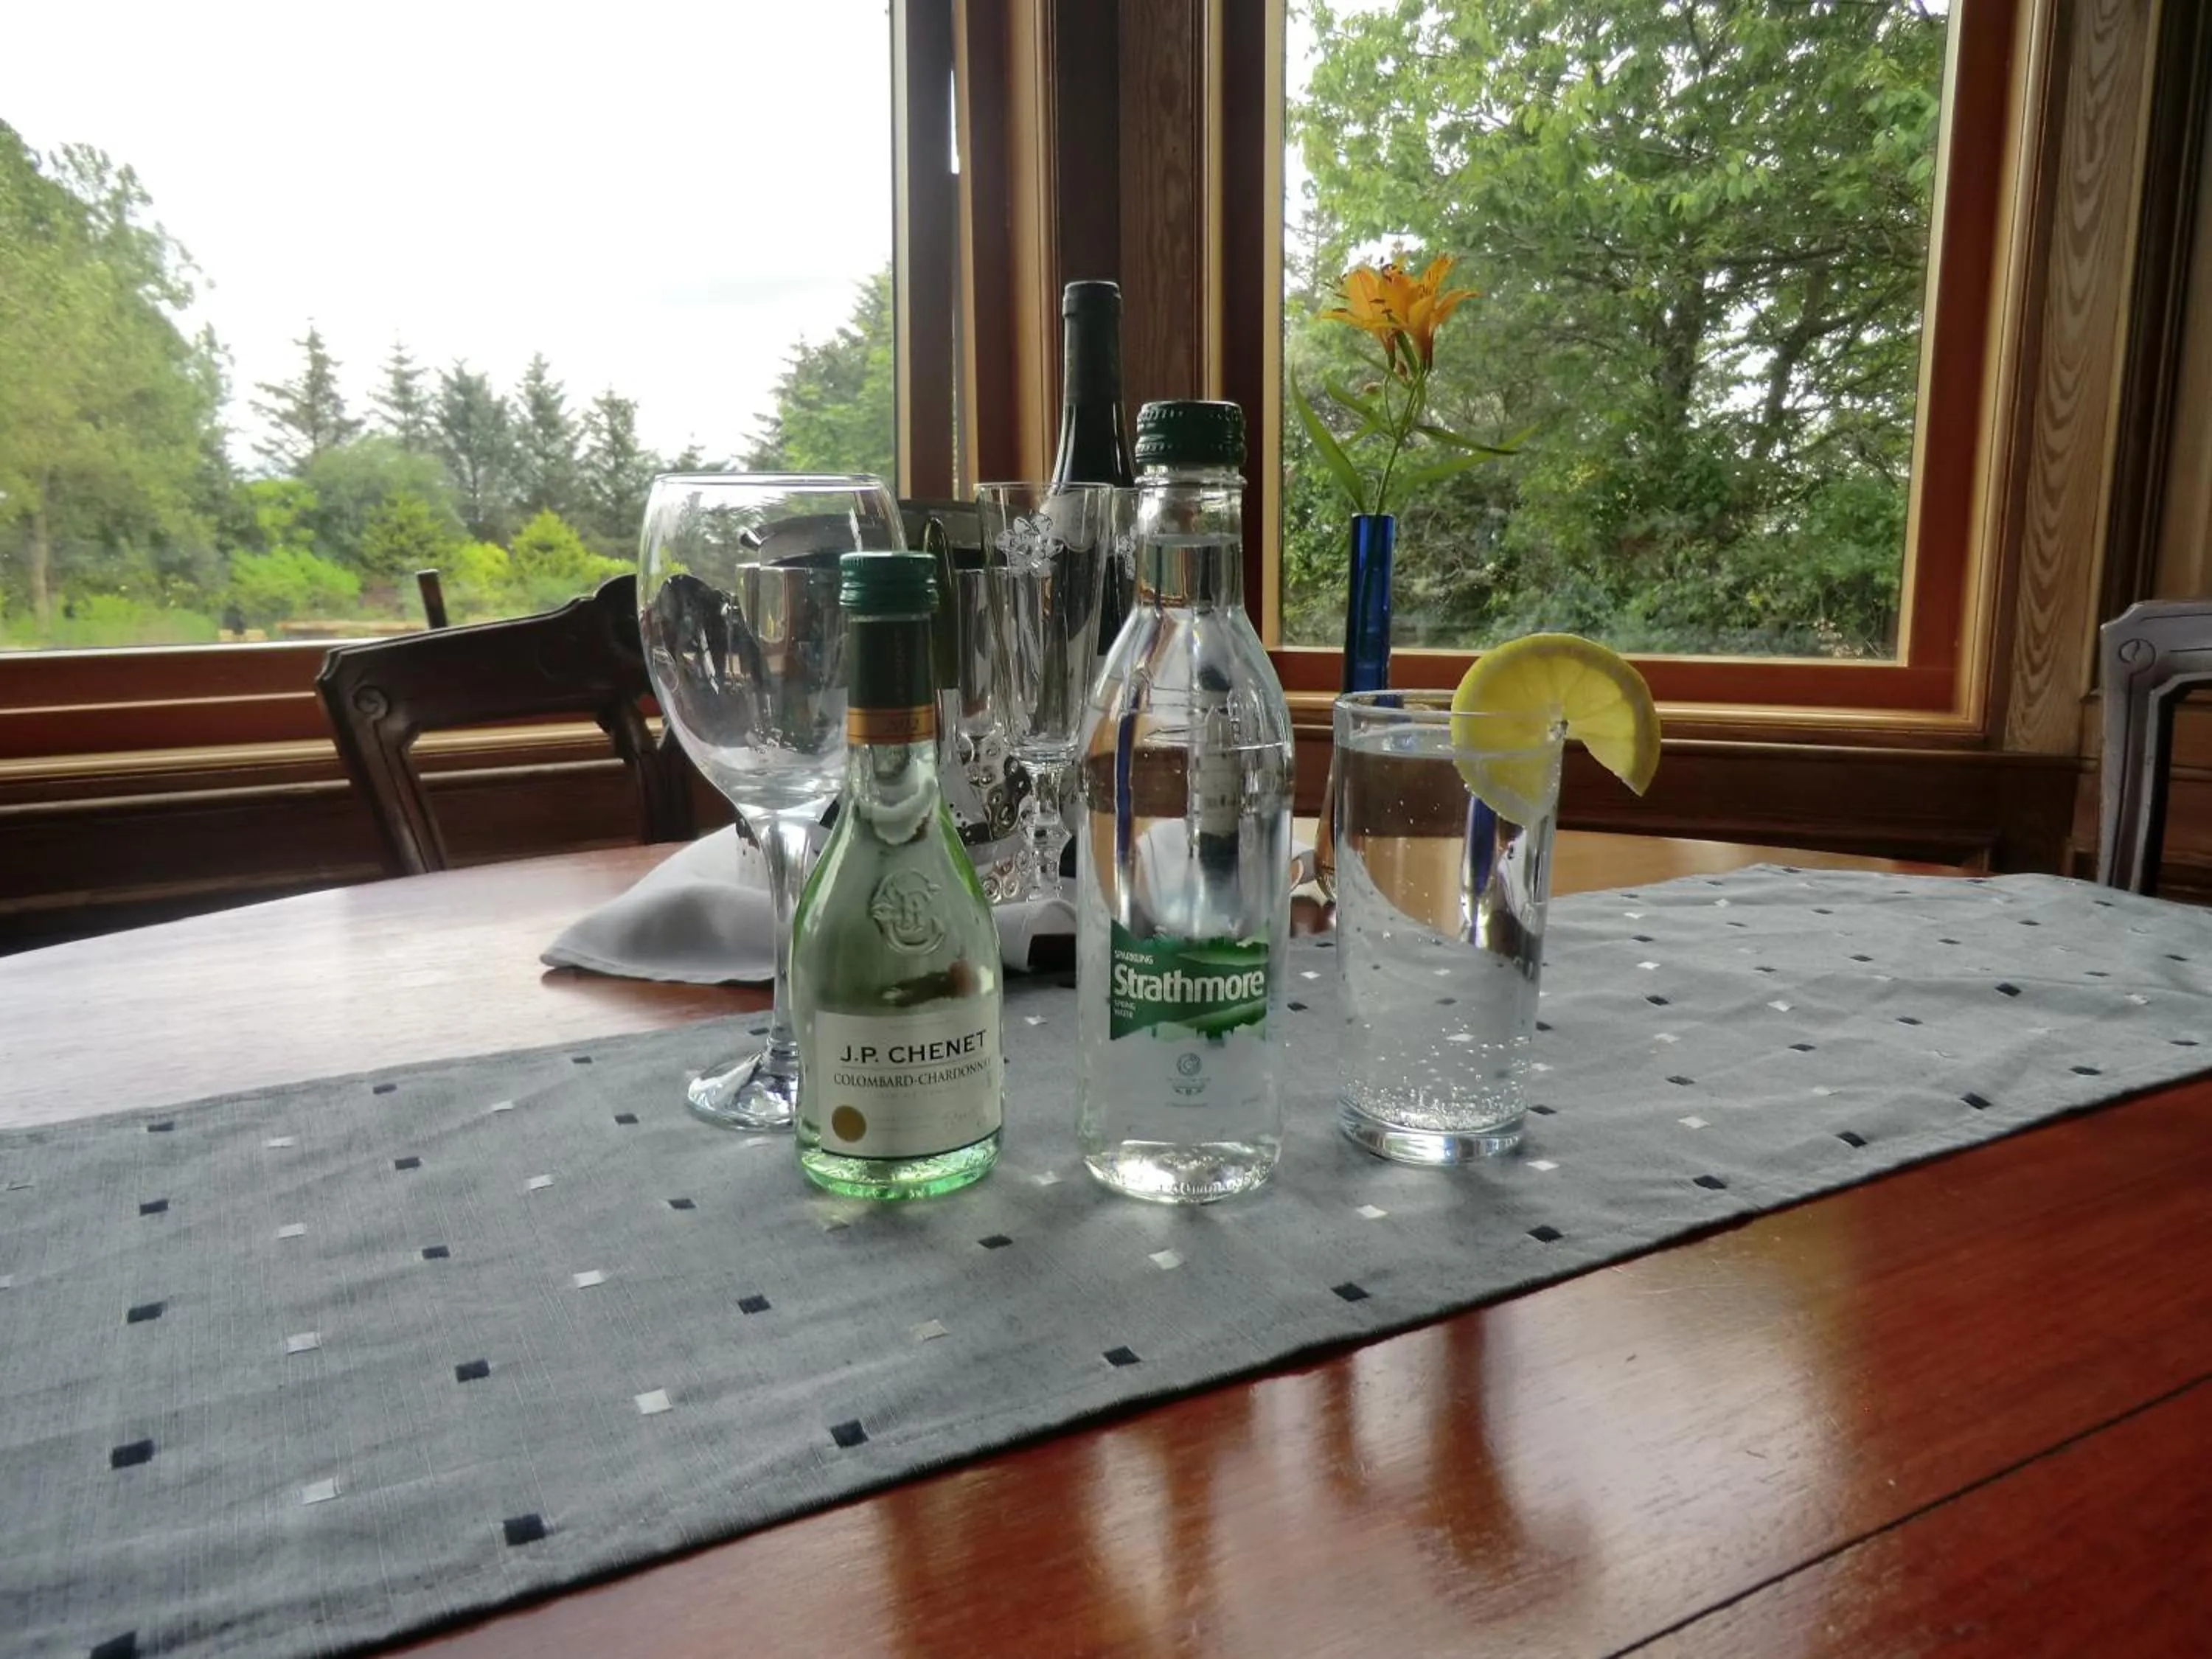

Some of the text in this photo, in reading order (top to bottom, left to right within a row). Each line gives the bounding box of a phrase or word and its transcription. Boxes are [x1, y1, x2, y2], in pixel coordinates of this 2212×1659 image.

[1114, 963, 1265, 1003] Strathmore
[840, 1029, 987, 1064] J.P. CHENET
